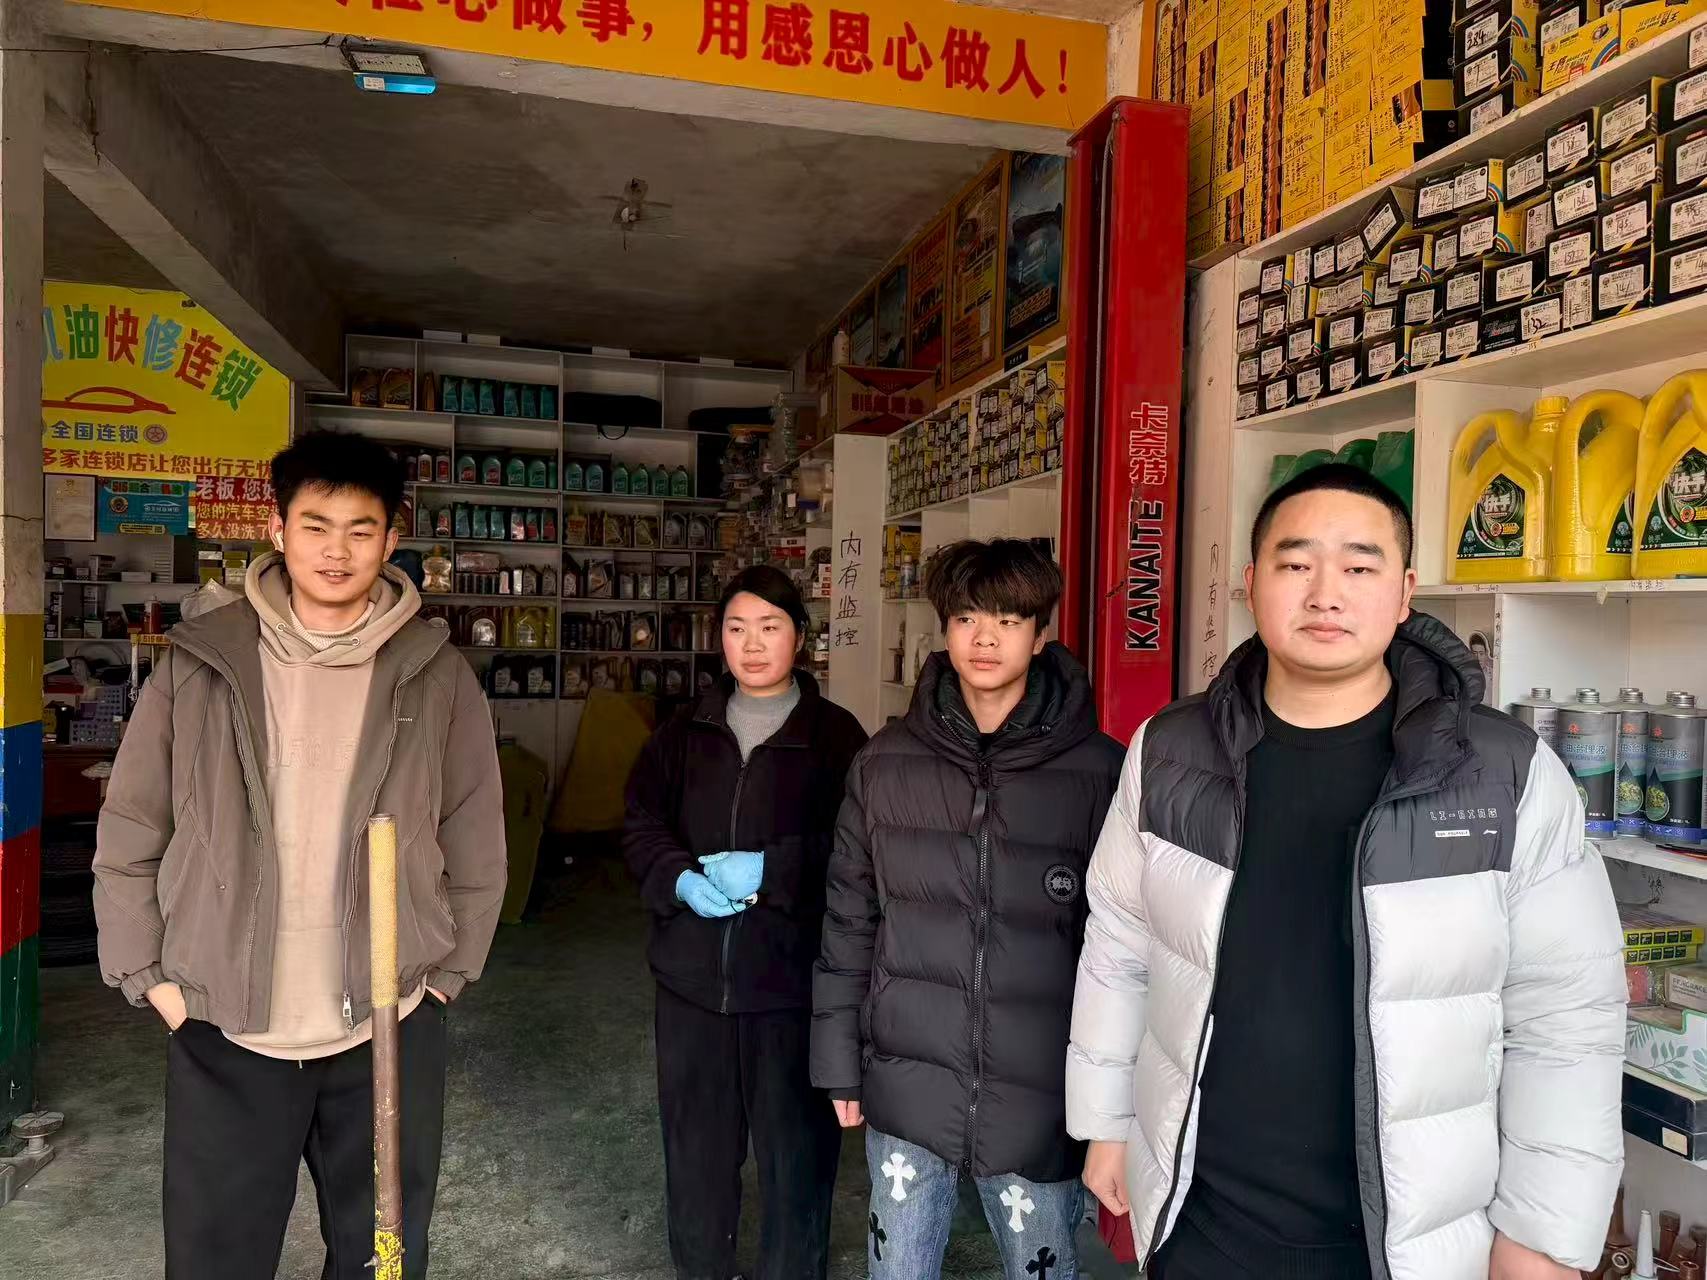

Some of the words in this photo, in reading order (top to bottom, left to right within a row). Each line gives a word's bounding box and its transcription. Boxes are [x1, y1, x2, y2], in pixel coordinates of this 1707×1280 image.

[51, 420, 139, 443] 全国连锁
[836, 530, 863, 647] 内有监控
[1125, 500, 1164, 651] KANAITE
